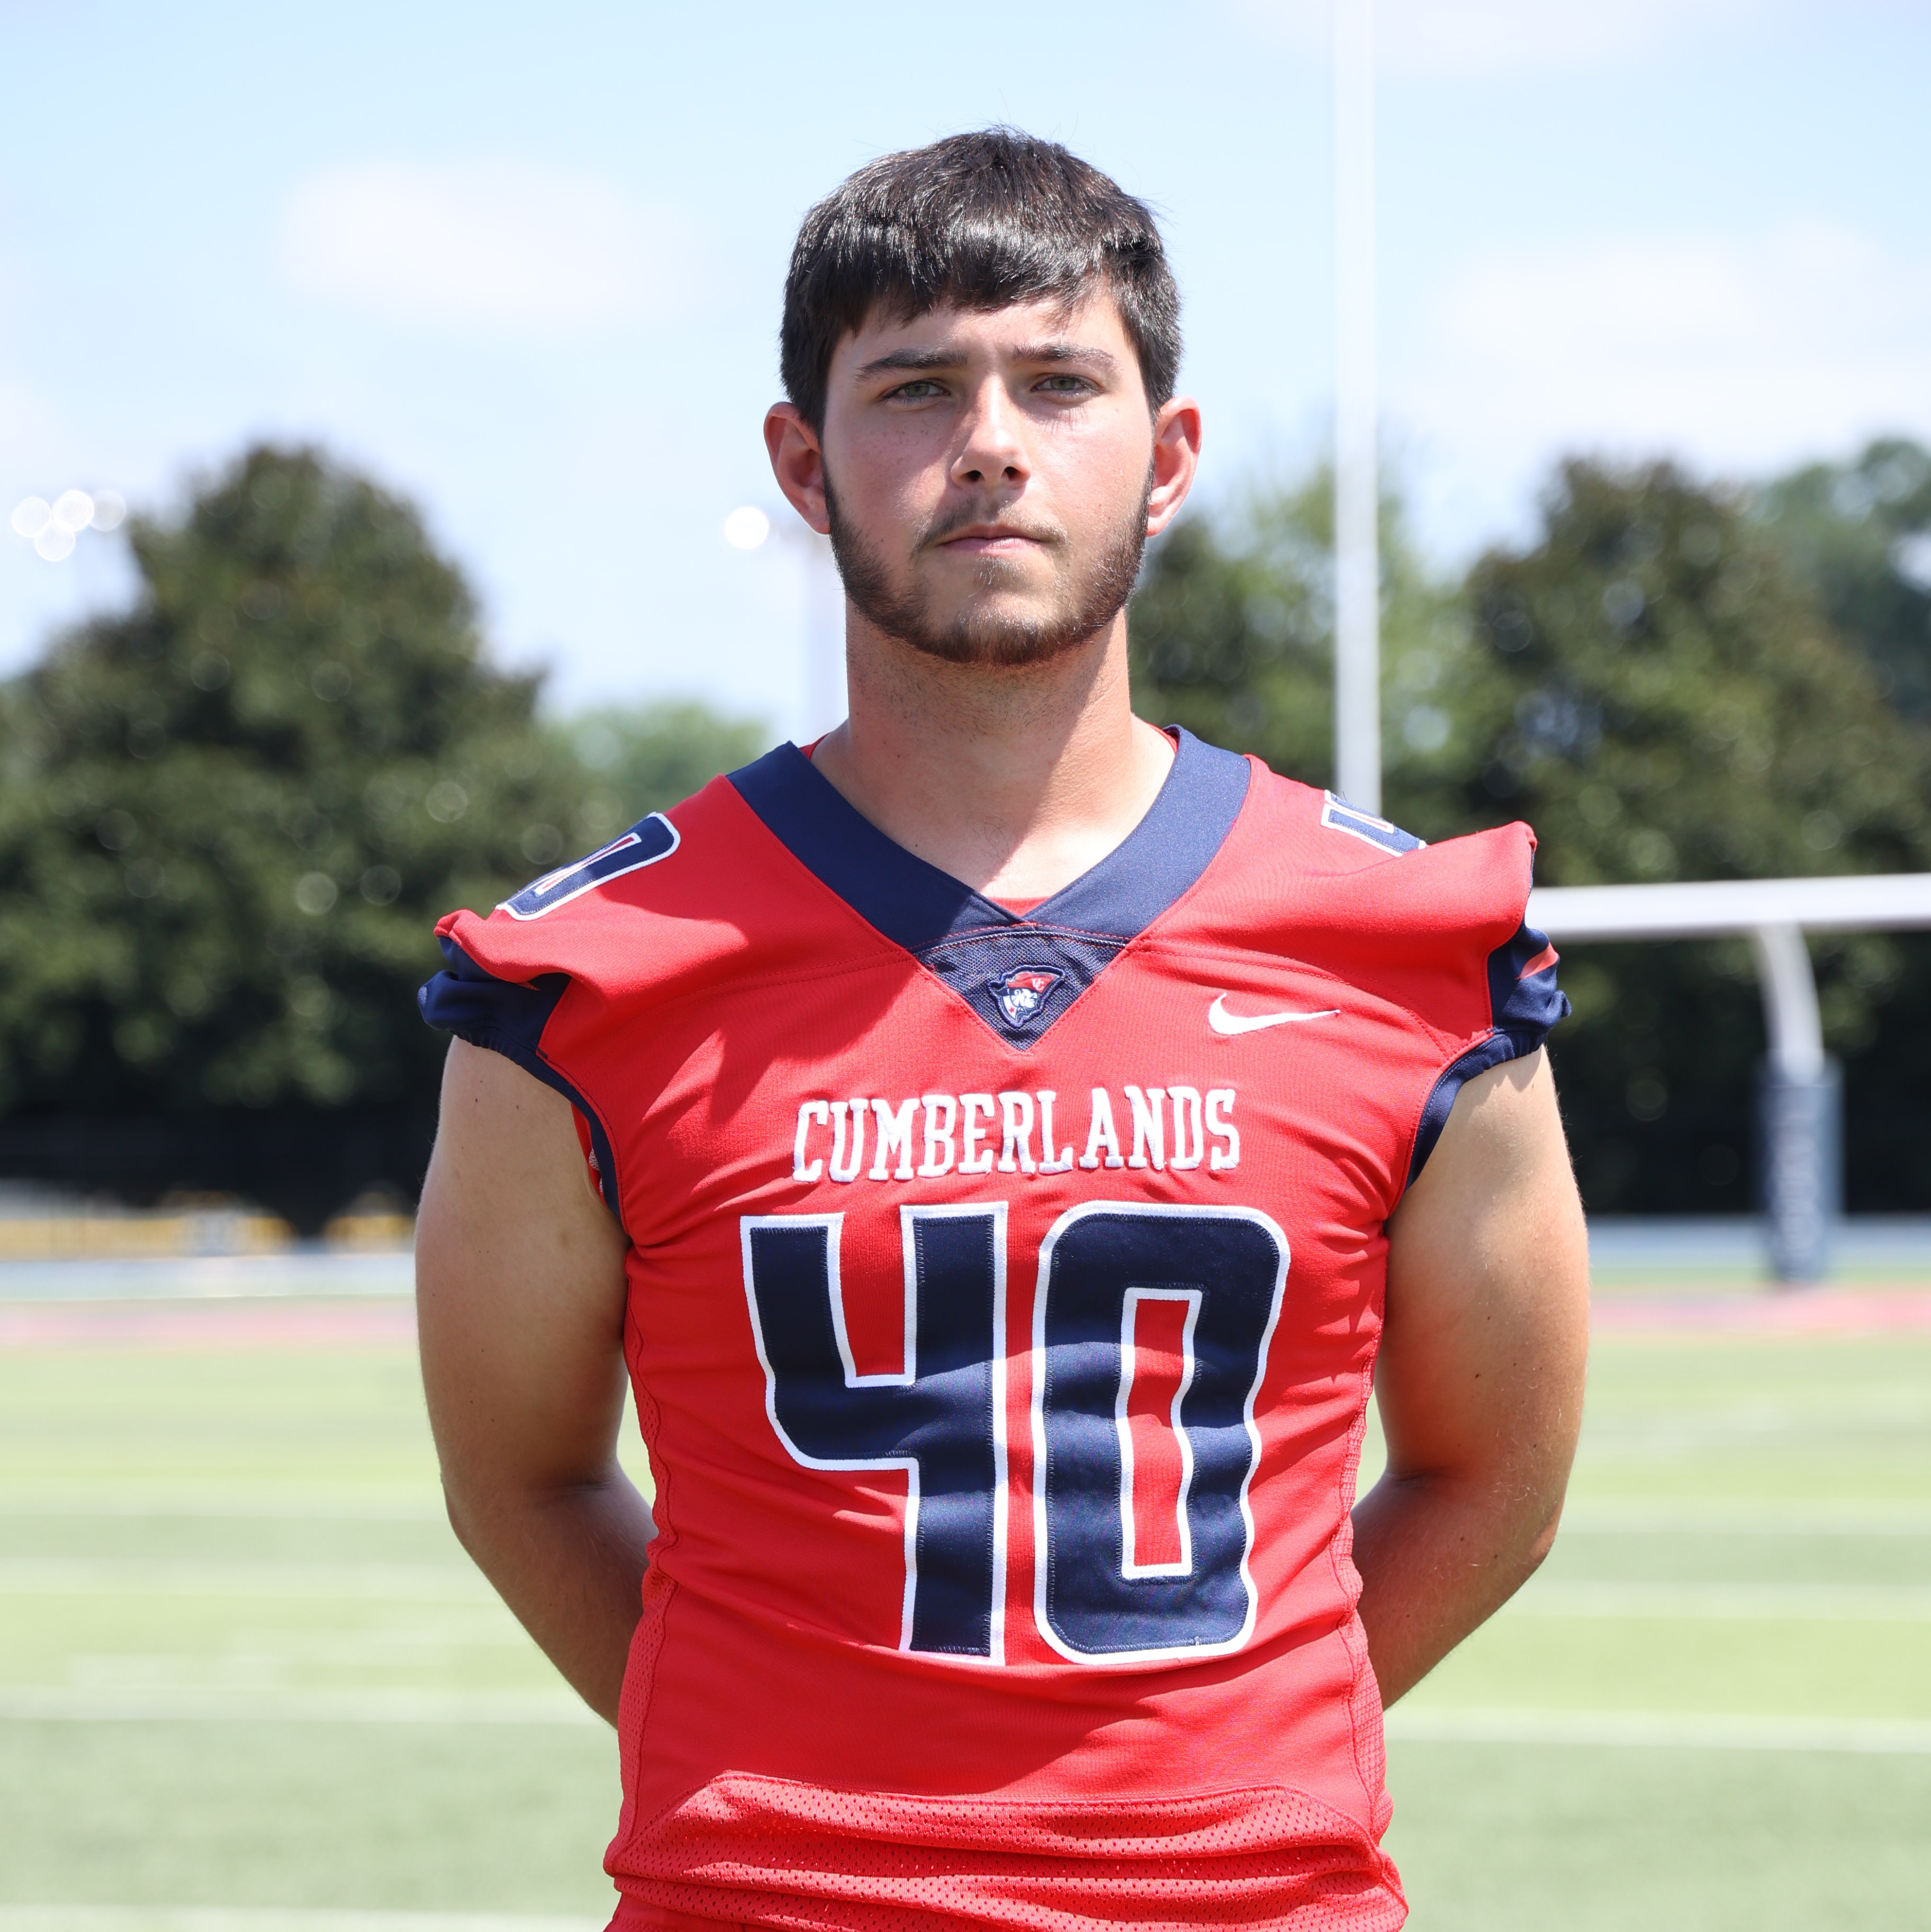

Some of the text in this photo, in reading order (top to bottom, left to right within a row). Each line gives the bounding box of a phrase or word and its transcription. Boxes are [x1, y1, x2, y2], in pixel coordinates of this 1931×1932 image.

[1032, 978, 1044, 991] UC
[792, 1086, 1240, 1183] CUMBERLANDS
[741, 1201, 1290, 1666] 40
